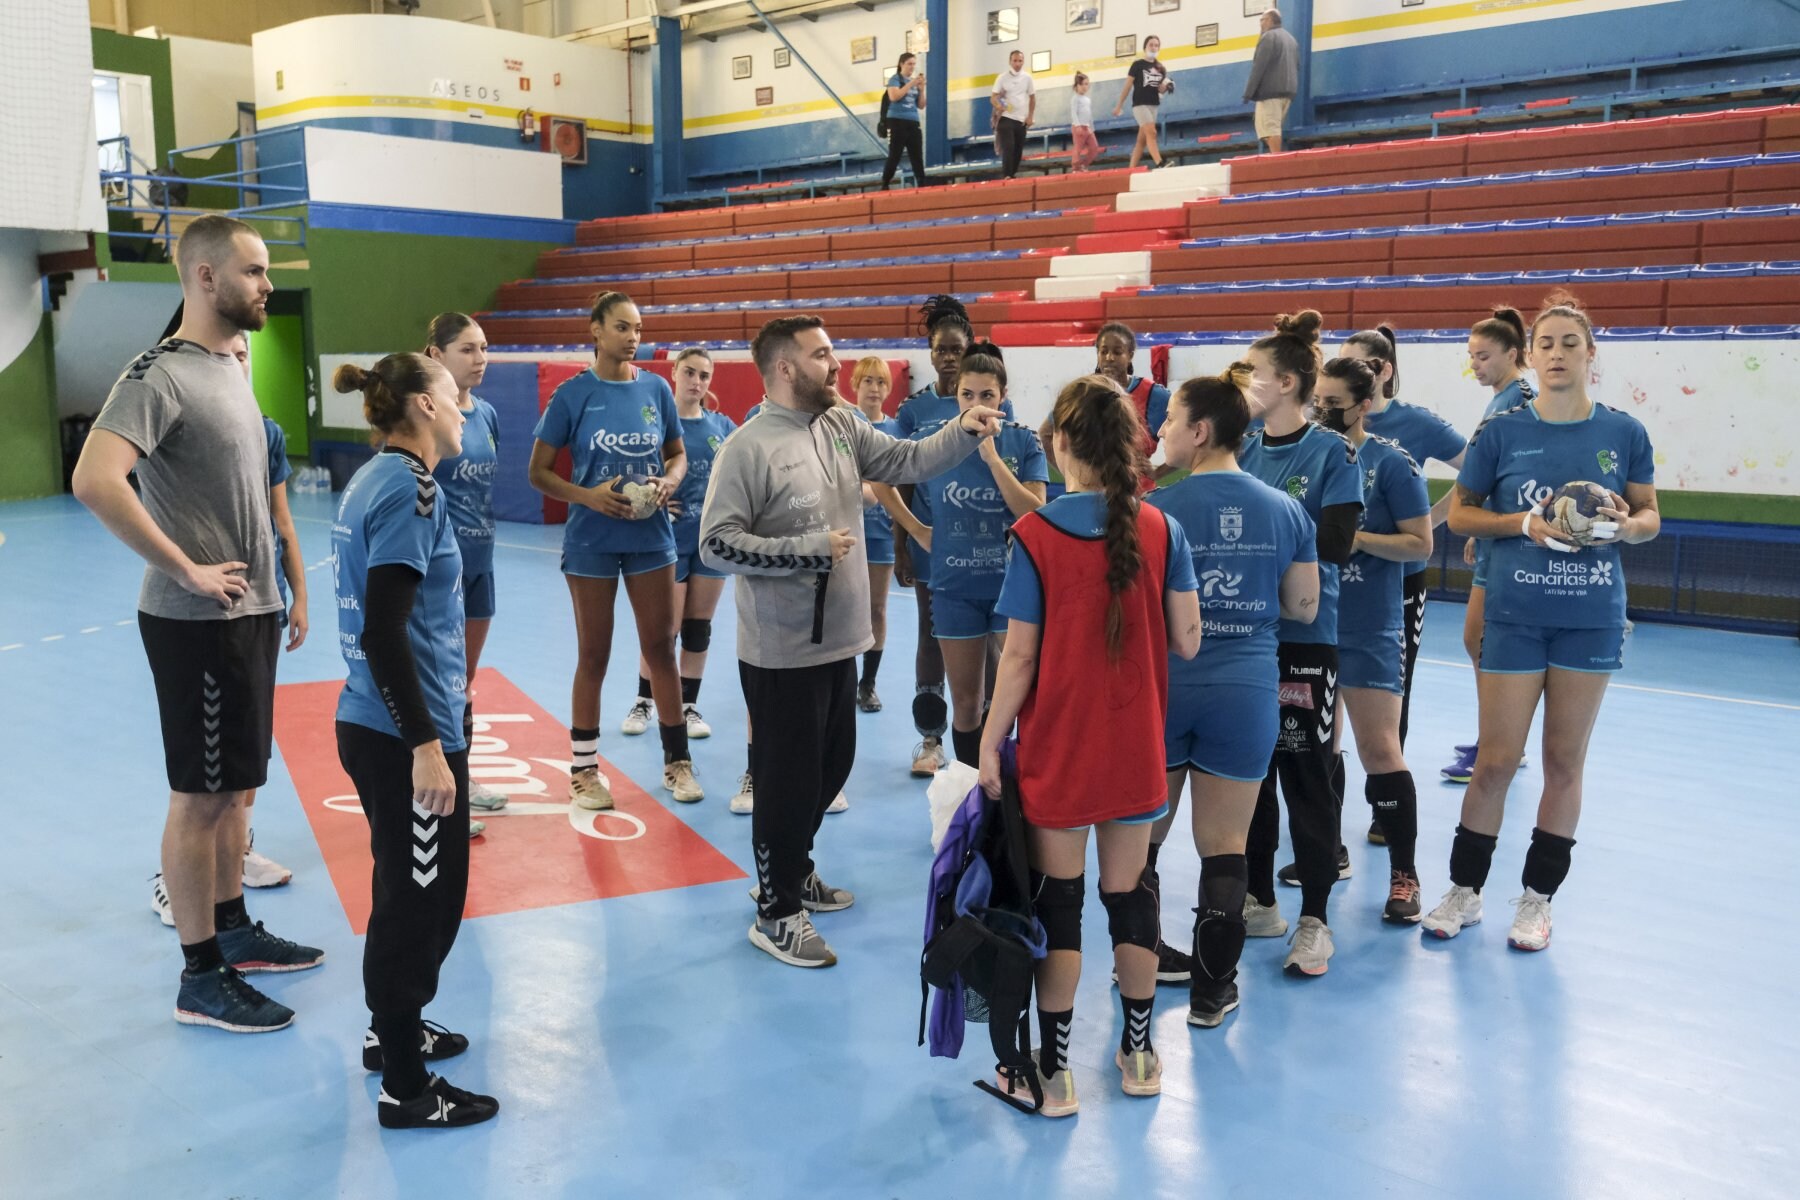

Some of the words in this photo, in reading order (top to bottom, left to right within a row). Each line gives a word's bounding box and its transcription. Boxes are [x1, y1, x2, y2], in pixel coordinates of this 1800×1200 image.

[432, 82, 500, 101] ASEOS
[590, 428, 659, 455] Rocasa
[946, 556, 1003, 568] Canarias
[1549, 560, 1587, 573] Islas
[1514, 570, 1588, 586] Canarias
[1201, 620, 1253, 633] obierno
[1291, 665, 1322, 676] hummel
[1279, 686, 1310, 703] Libby's
[382, 686, 402, 728] KIPSTA
